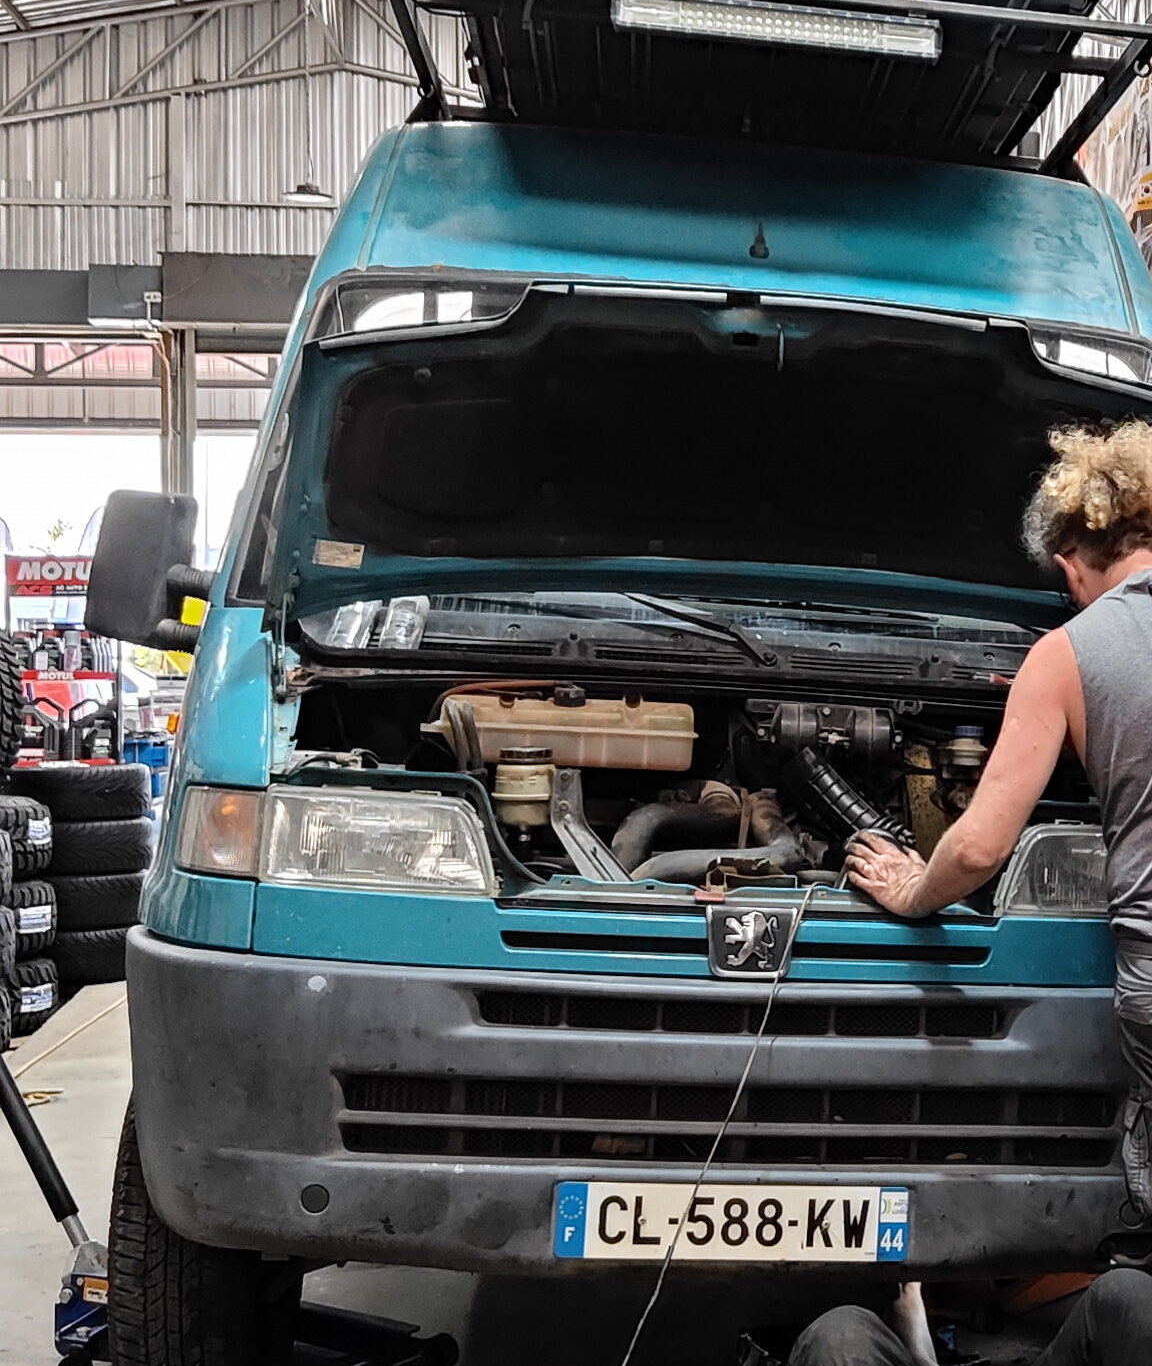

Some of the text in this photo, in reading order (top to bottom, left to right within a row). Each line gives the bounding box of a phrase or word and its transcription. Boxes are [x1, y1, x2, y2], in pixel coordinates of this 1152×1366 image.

[17, 561, 92, 581] MOTU
[38, 671, 75, 680] MOTUL
[598, 1195, 871, 1249] CL-588-KW
[563, 1226, 575, 1243] F
[880, 1228, 904, 1252] 44
